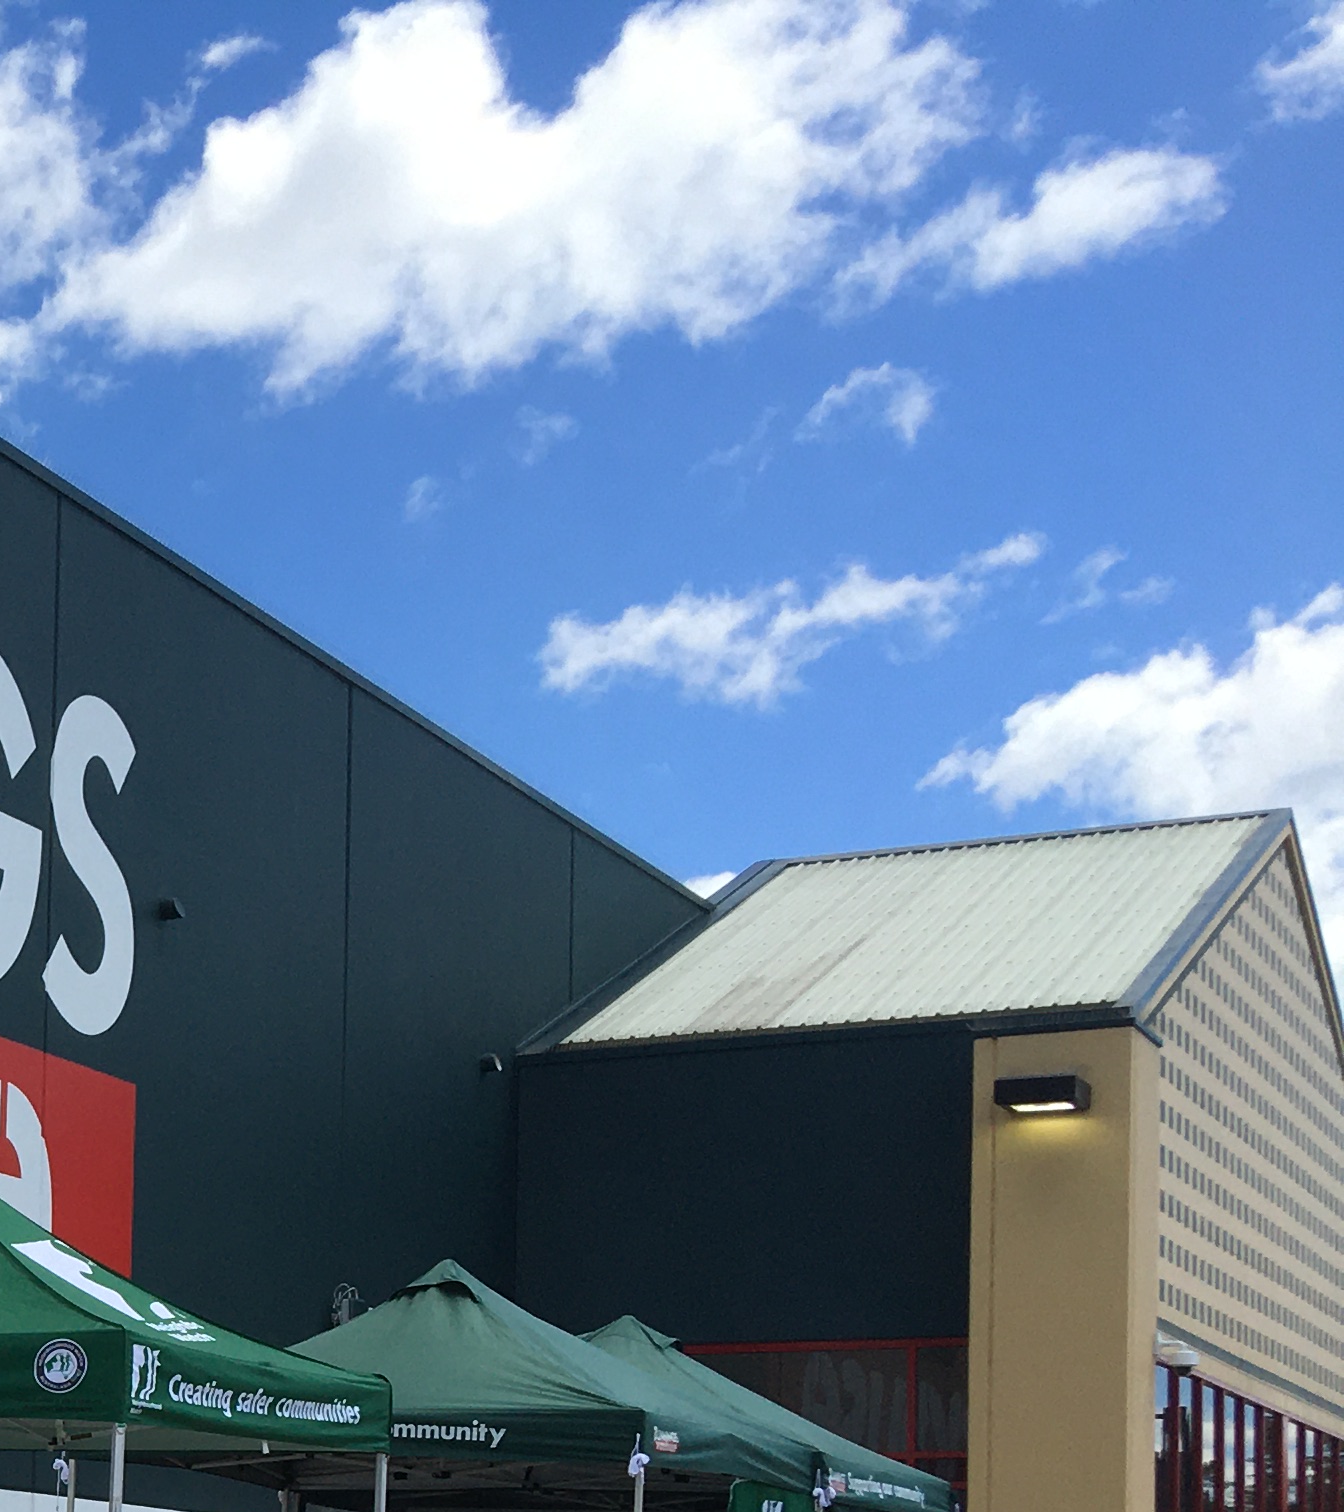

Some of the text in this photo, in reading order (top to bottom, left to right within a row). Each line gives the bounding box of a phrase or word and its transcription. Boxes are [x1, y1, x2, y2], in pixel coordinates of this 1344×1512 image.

[168, 1373, 234, 1418] Creating
[236, 1388, 275, 1416] safer
[275, 1398, 361, 1425] communities
[391, 1419, 507, 1449] mmunity
